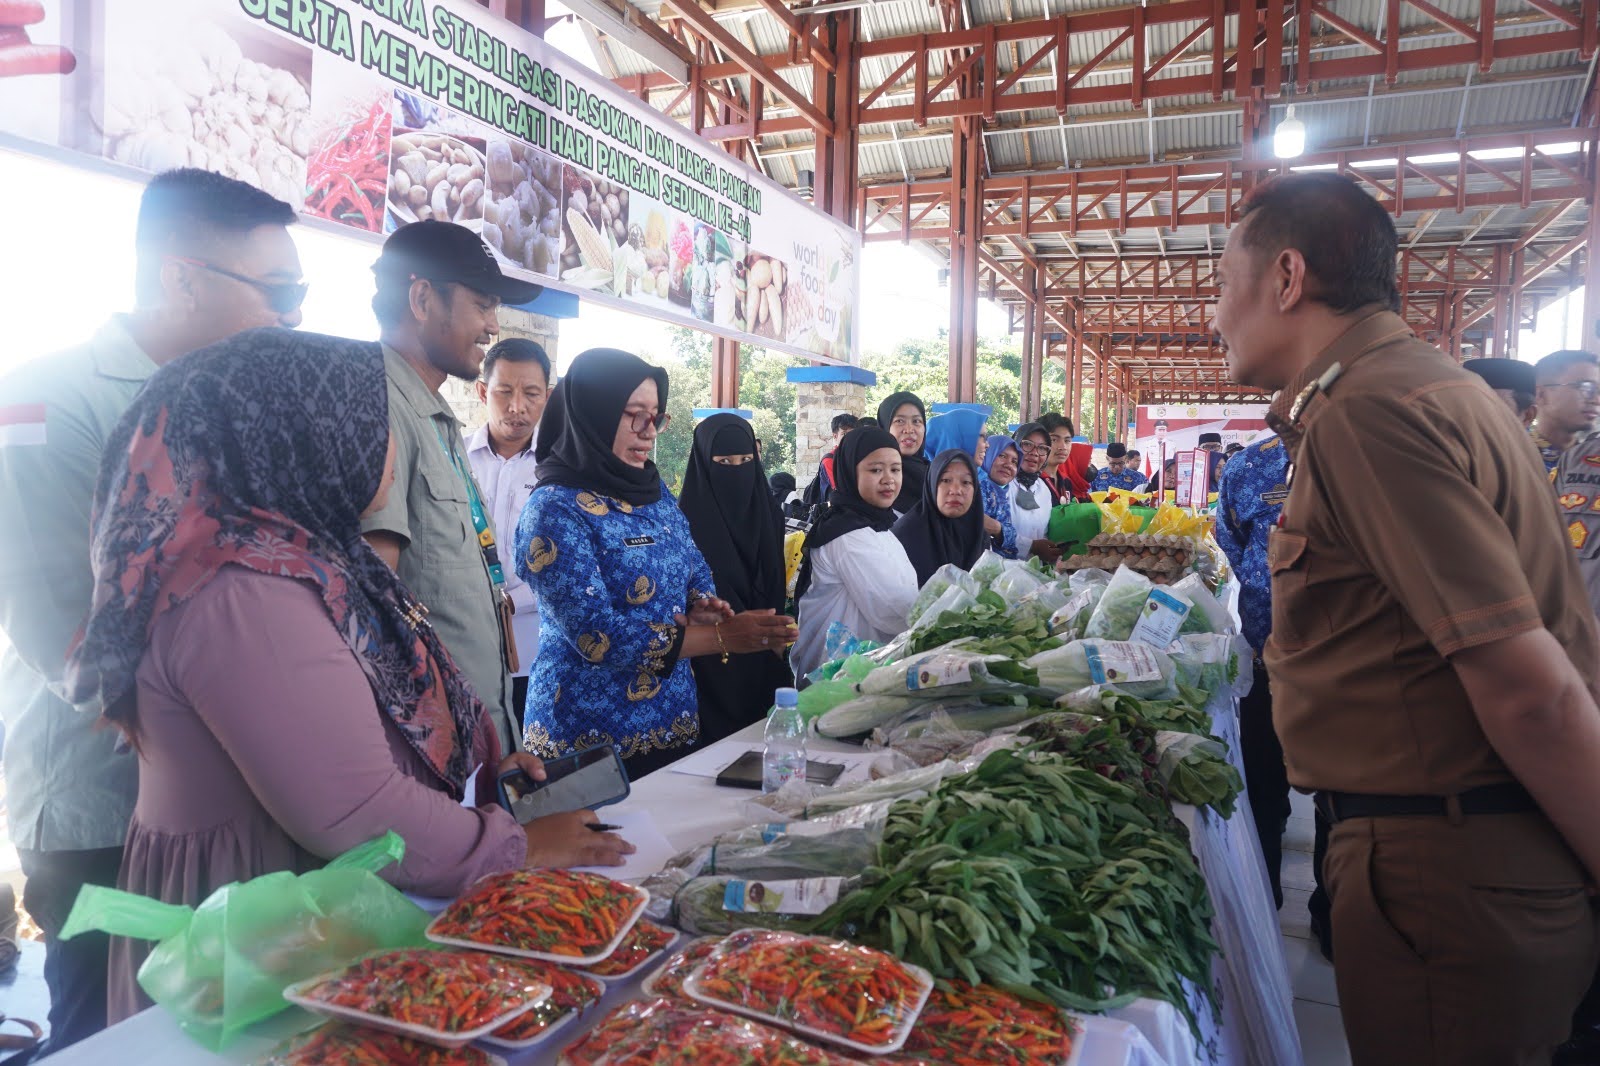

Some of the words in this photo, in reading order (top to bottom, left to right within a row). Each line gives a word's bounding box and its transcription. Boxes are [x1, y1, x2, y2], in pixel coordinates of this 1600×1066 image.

[433, 5, 562, 110] STABILISASI
[565, 79, 642, 152] PASOKAN
[645, 125, 674, 169] DAN
[676, 143, 718, 193] HARGA
[720, 168, 761, 215] PANGAN
[361, 20, 546, 149] MEMPERINGATI
[550, 116, 593, 170] HARI
[597, 140, 659, 200] PANGAN
[662, 174, 716, 227] SEDUNIA
[718, 202, 751, 244] KE-44
[793, 241, 825, 271] world
[800, 265, 825, 296] food
[817, 300, 836, 332] day
